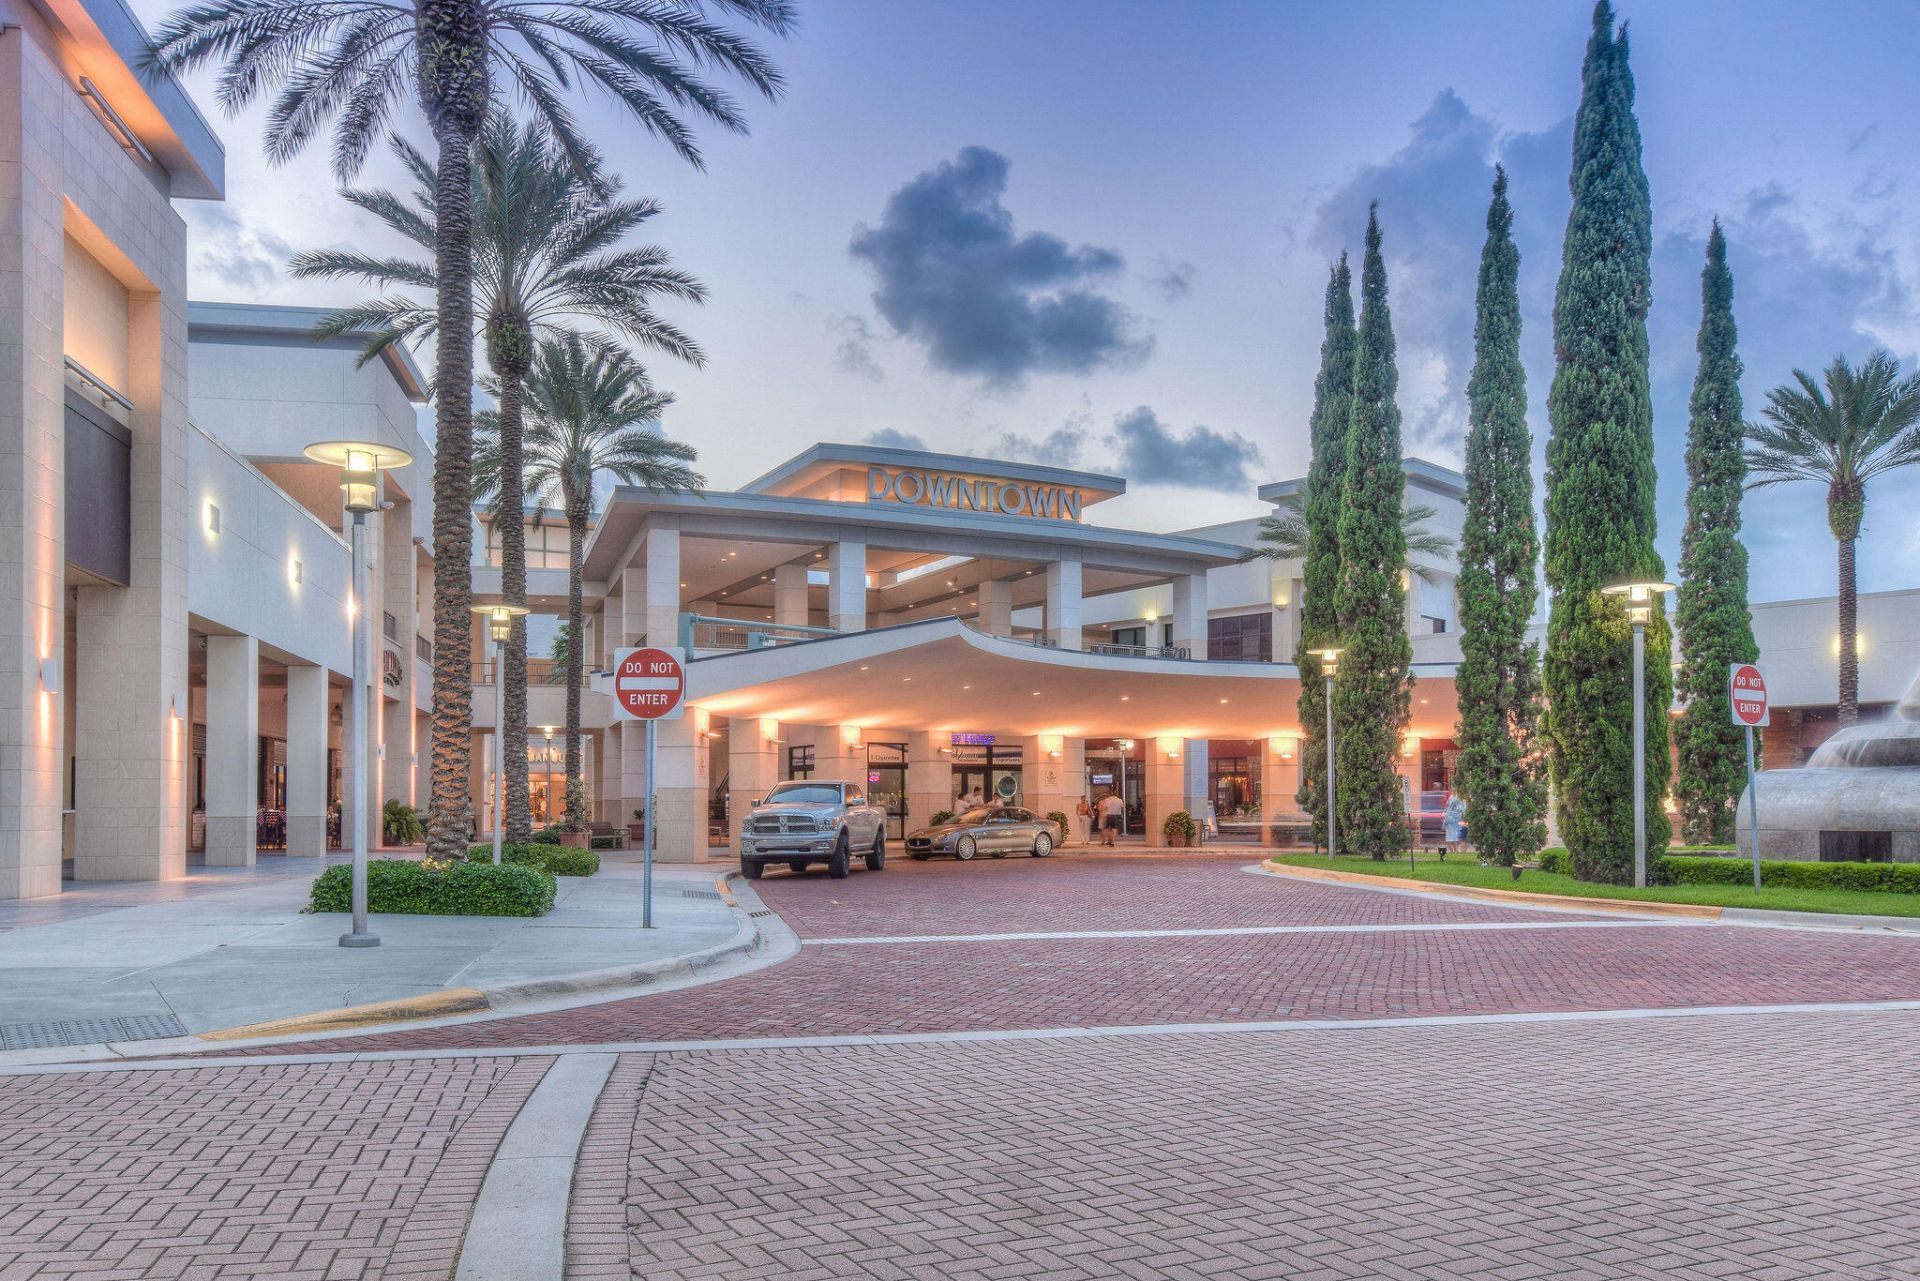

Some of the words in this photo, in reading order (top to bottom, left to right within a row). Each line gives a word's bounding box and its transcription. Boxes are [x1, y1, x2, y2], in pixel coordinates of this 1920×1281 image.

[868, 466, 1082, 520] DOWNTOWN
[626, 662, 642, 674] DO
[650, 662, 674, 674] NOT
[1736, 676, 1746, 686] DO
[1749, 678, 1761, 688] NOT
[629, 693, 668, 705] ENTER
[1740, 703, 1761, 714] ENTER
